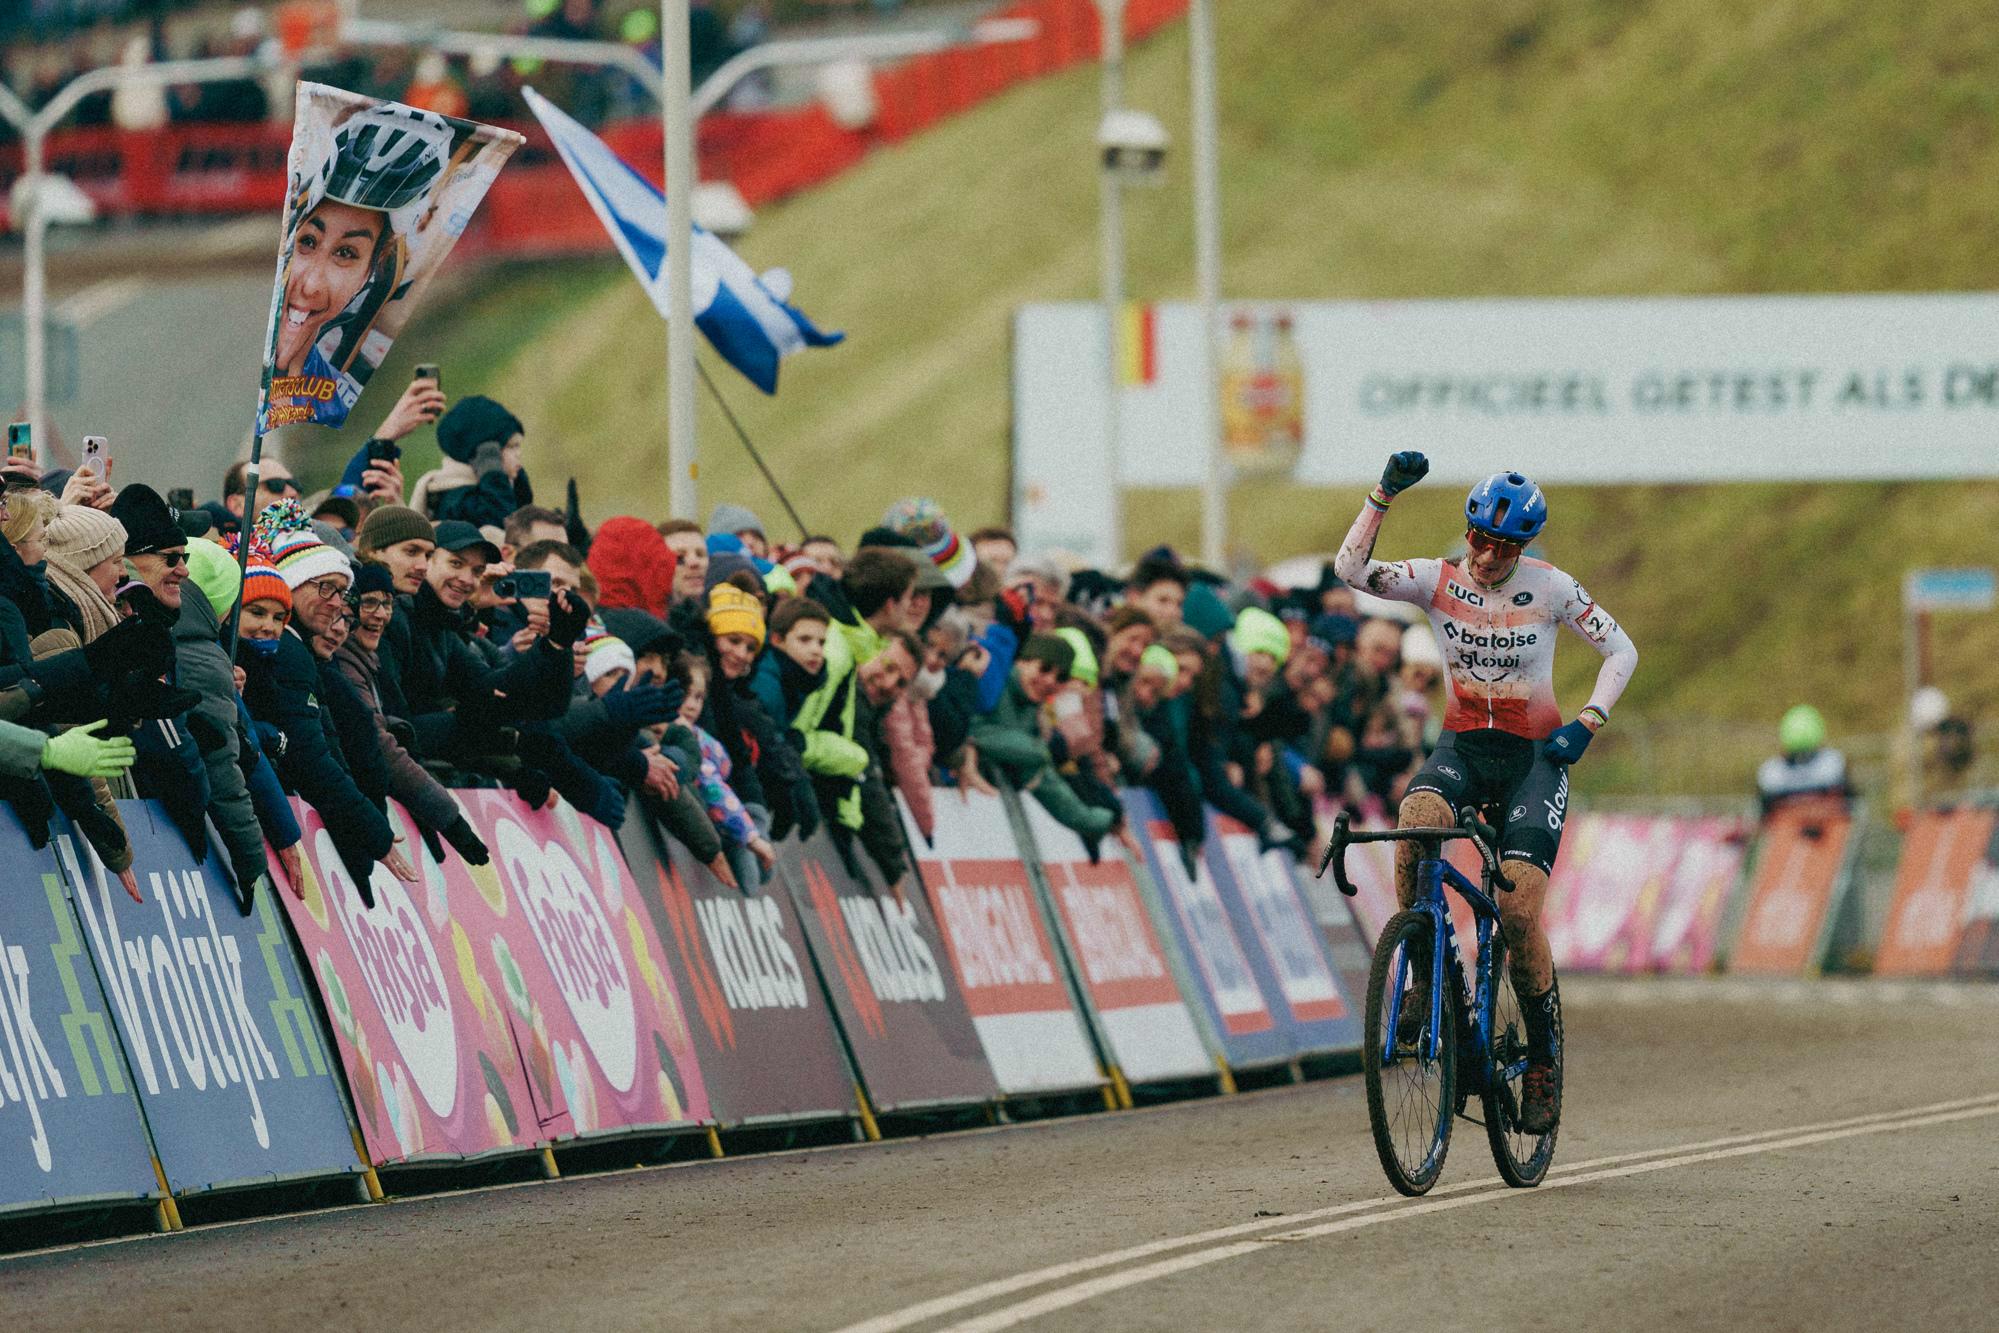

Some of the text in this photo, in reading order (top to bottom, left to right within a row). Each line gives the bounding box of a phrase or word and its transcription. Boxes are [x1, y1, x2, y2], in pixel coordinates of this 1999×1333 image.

[1455, 585, 1484, 607] UCI
[1588, 616, 1604, 632] 2
[1460, 651, 1520, 670] glowi
[58, 834, 280, 1150] Vrolijk
